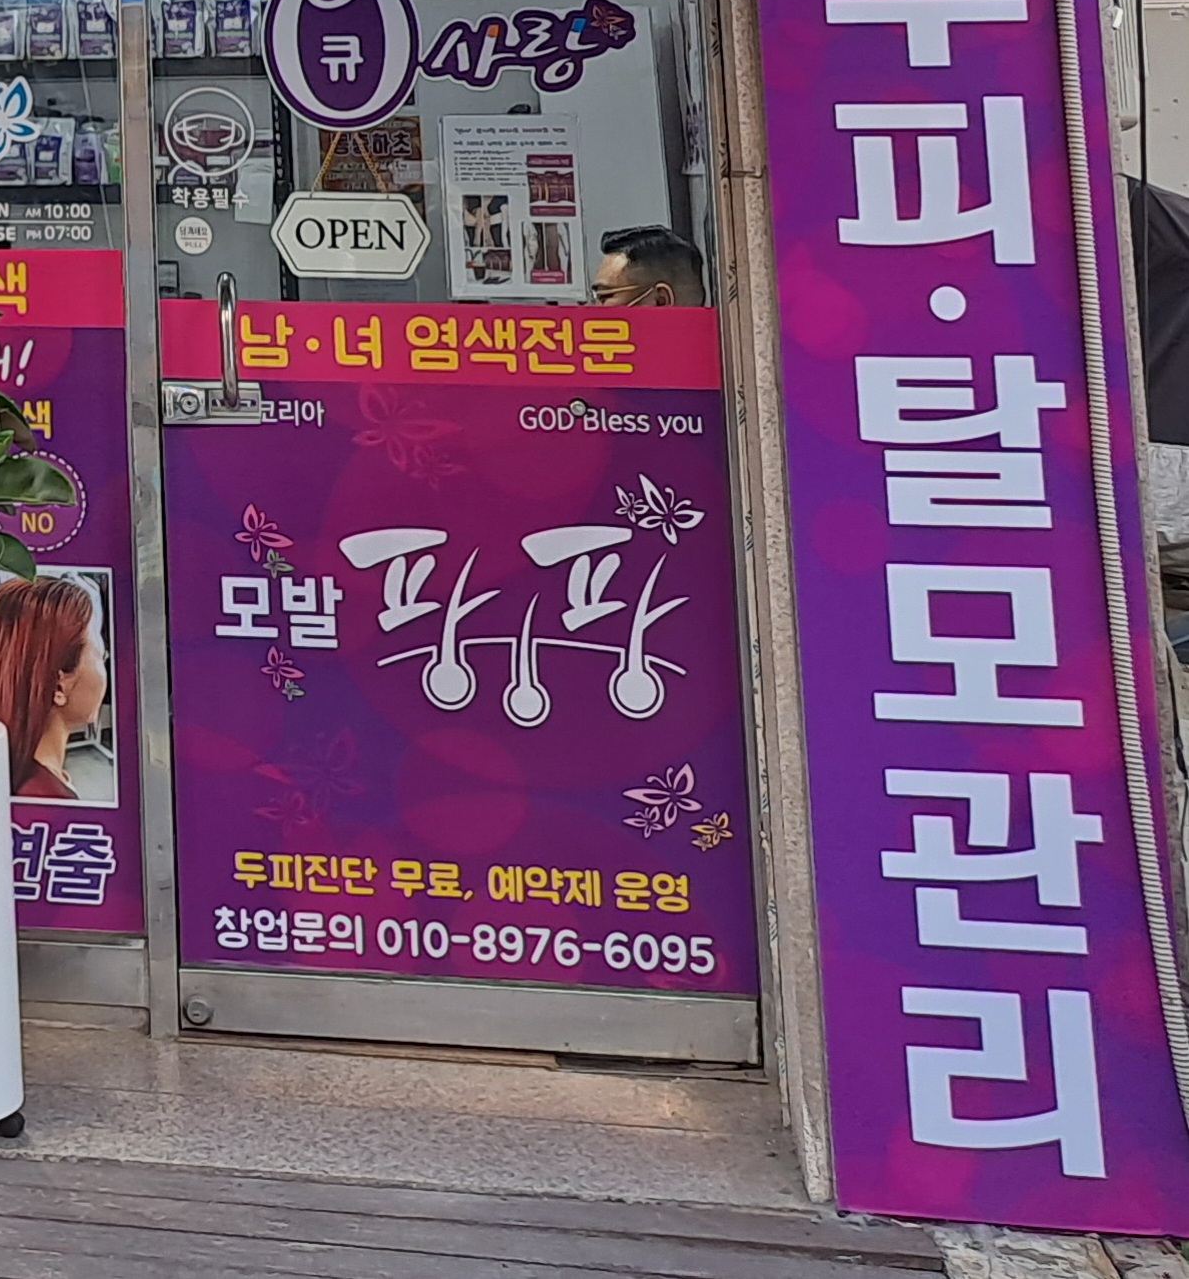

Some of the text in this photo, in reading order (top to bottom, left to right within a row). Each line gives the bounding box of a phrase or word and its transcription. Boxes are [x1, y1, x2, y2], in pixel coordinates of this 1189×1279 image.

[44, 203, 92, 218] 10:00
[171, 186, 250, 211] 착용필수
[44, 225, 92, 241] 07:00
[294, 217, 408, 251] OPEN
[405, 316, 637, 374] 염색전문
[519, 406, 703, 438] GOD Bless you
[21, 511, 54, 534] NO
[215, 575, 344, 650] 모발
[233, 851, 378, 897] 두피진단
[486, 864, 602, 908] 예약제
[613, 872, 690, 913] 운영
[213, 906, 716, 975] 창업문의 010-8976-6095
